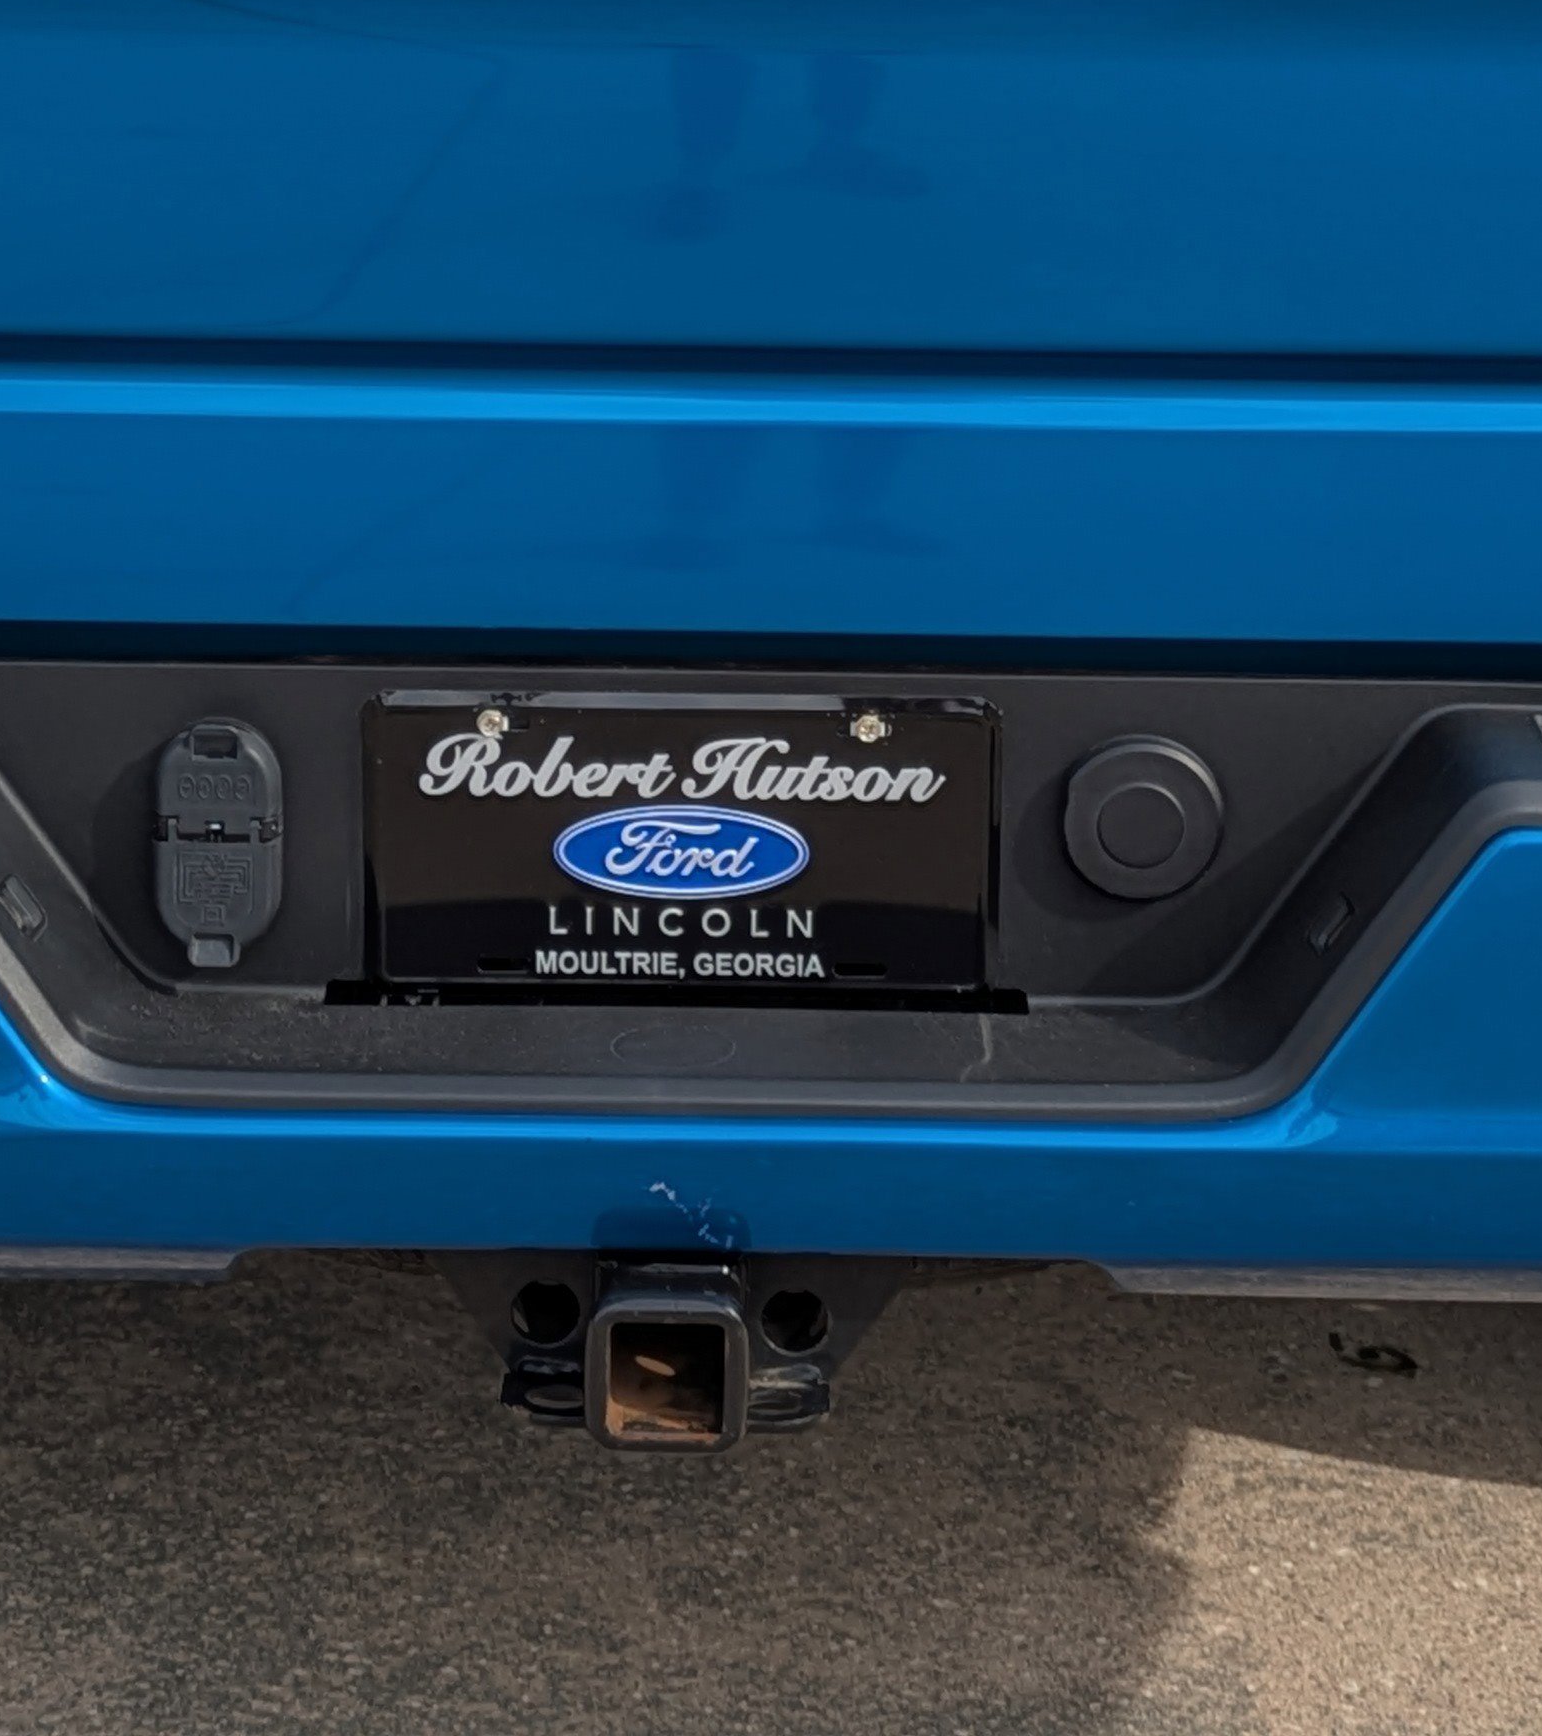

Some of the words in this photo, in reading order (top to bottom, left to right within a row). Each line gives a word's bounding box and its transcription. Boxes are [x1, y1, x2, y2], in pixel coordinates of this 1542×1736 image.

[418, 732, 677, 798] Robert
[680, 736, 947, 803] Hutson
[605, 820, 758, 879] Ford
[548, 906, 815, 939] LINCOLN
[535, 950, 686, 980] MOULTRIE,
[692, 952, 825, 979] GEORGIA
